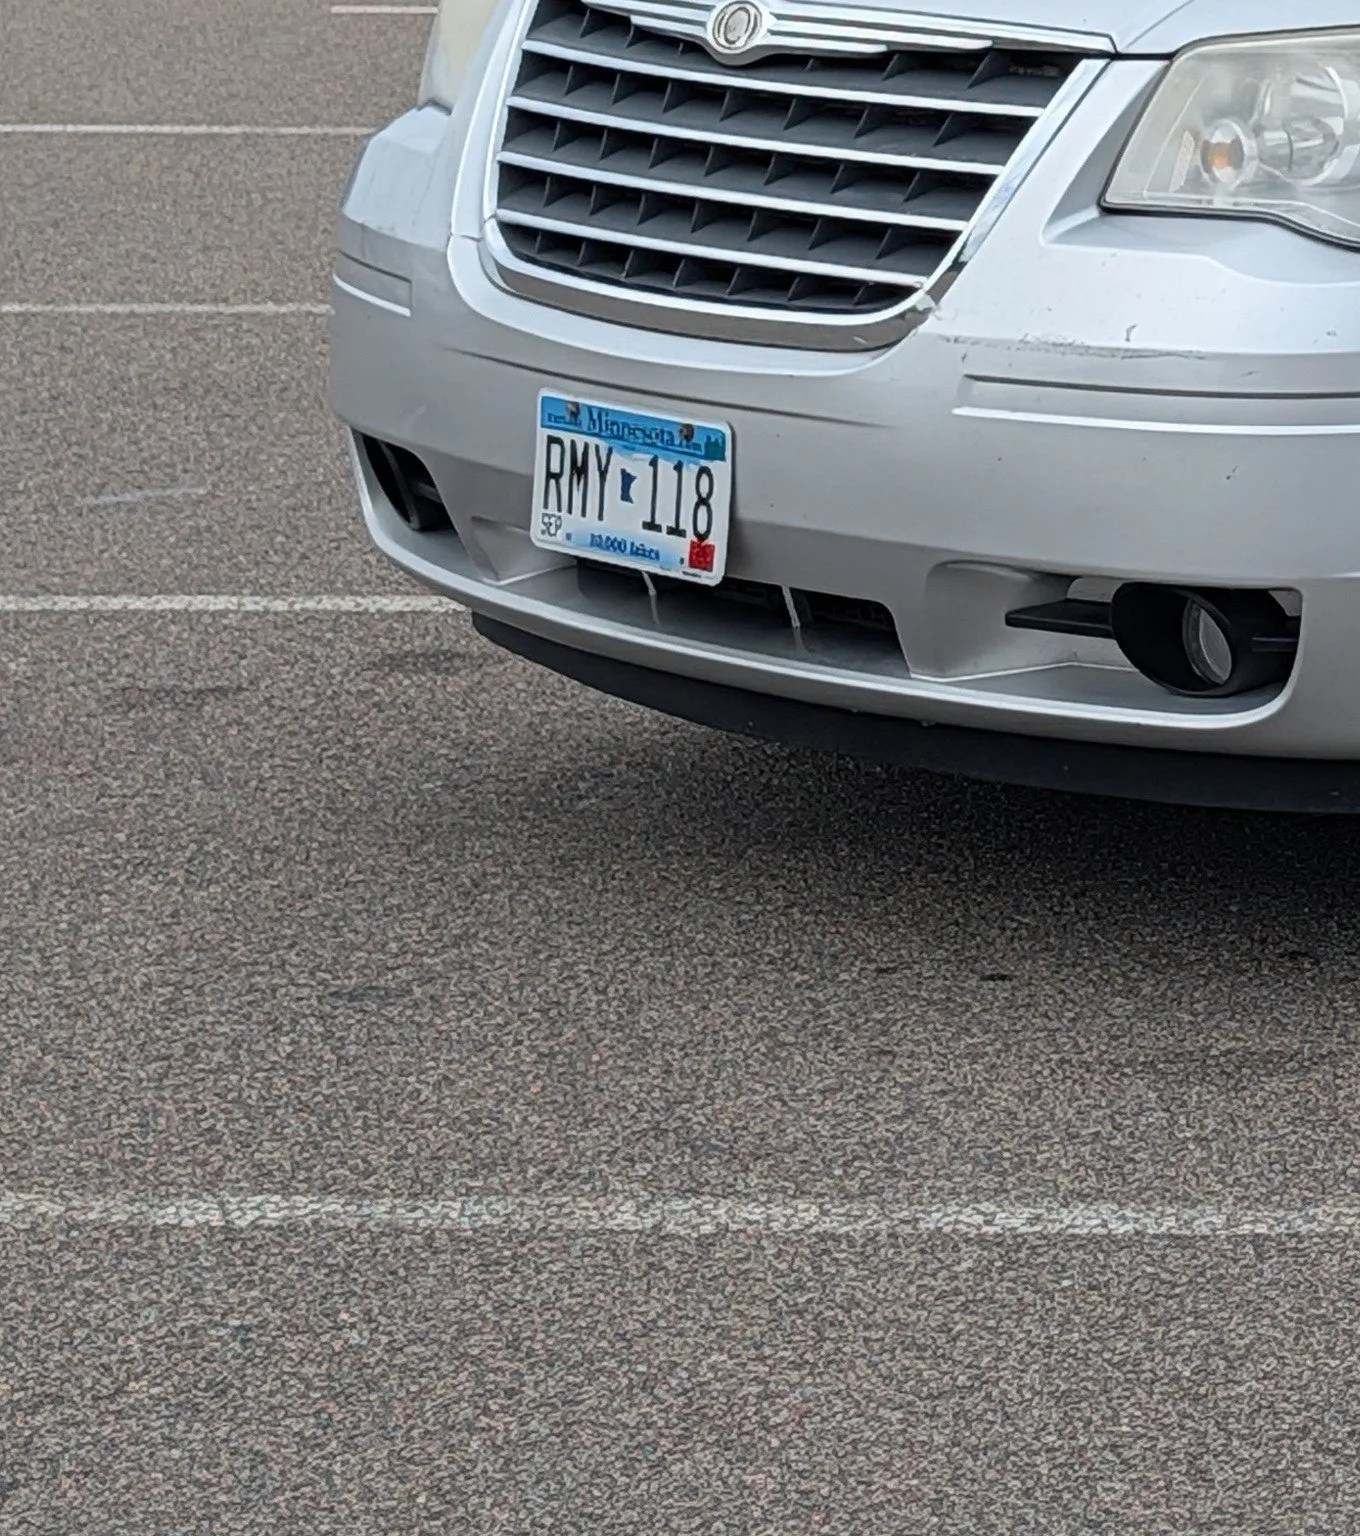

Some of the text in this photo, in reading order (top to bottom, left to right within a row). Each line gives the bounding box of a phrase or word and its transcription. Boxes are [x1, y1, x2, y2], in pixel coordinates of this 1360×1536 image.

[586, 406, 675, 446] Minnesota
[543, 434, 714, 542] RMY 118
